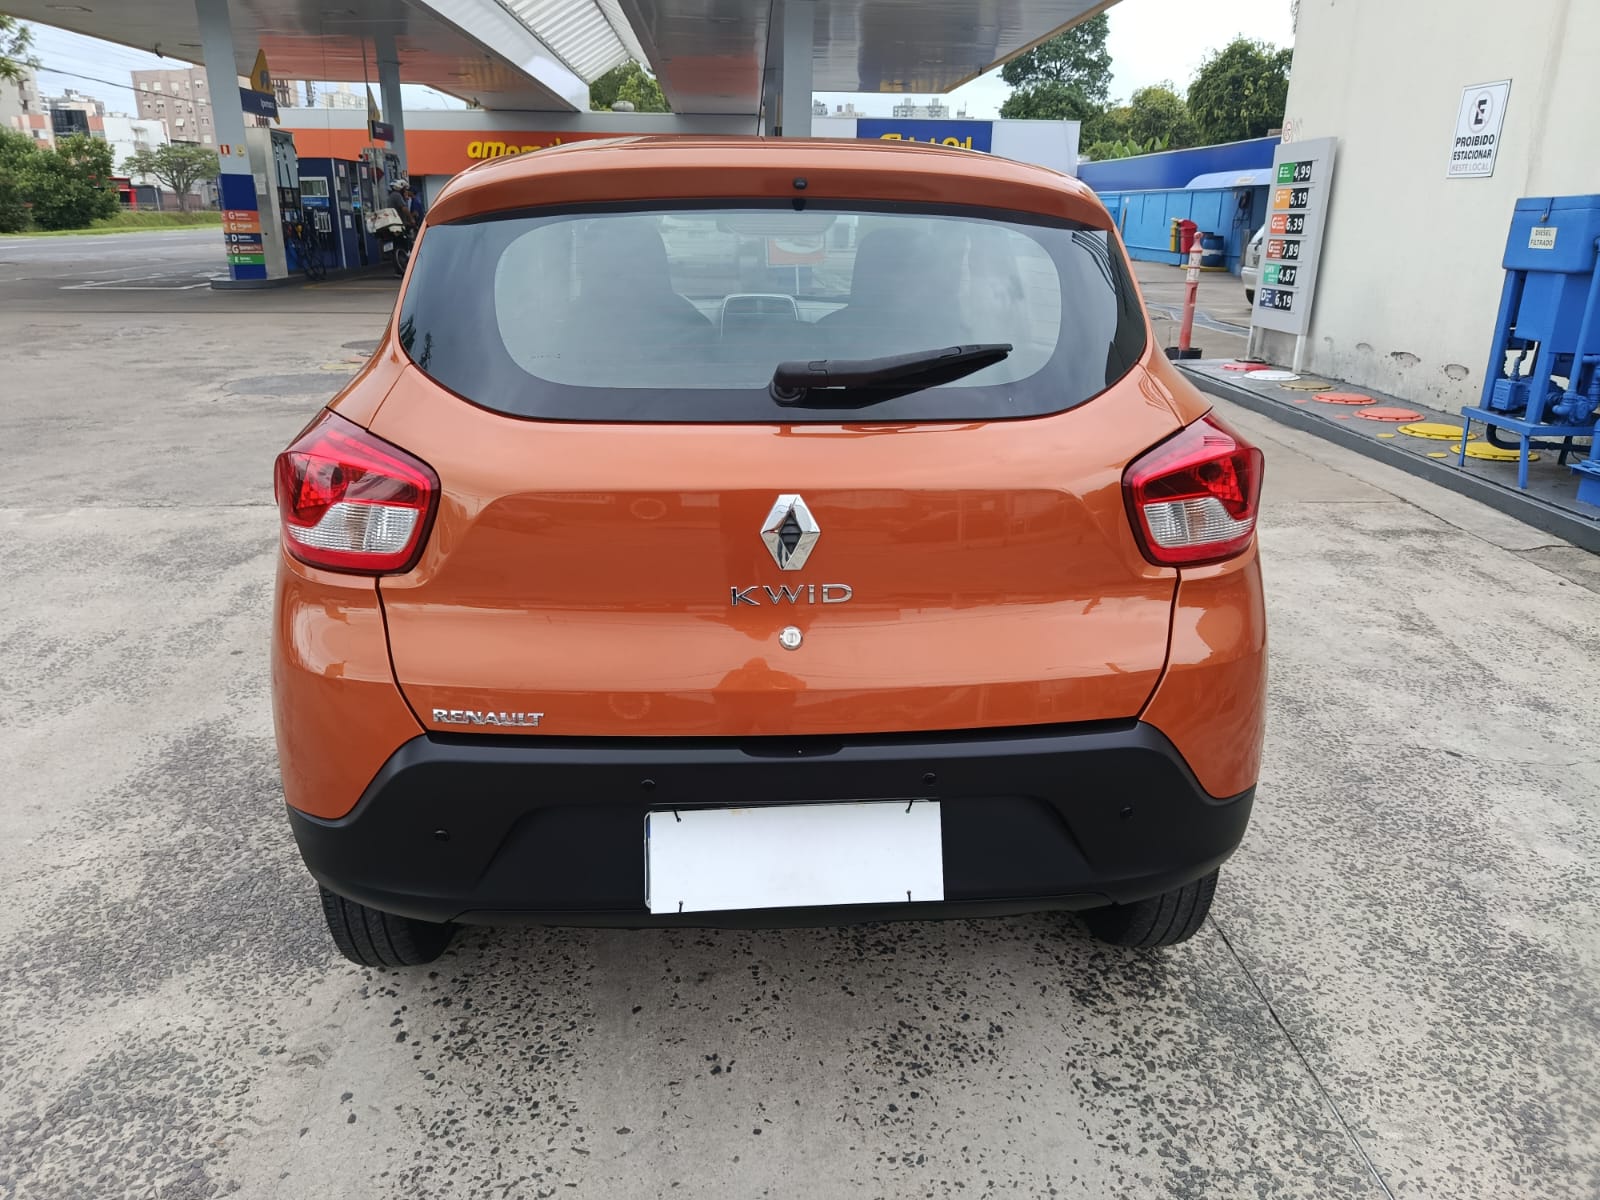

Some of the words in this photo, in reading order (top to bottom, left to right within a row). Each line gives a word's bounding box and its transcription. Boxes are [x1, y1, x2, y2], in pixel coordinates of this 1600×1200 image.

[1456, 134, 1495, 147] PROIBIDO
[1453, 150, 1492, 161] ESTACIONAR
[1294, 166, 1311, 180] 4,99
[1469, 162, 1489, 172] LOCAL
[1276, 190, 1281, 203] G
[1290, 192, 1307, 206] 6,19
[229, 212, 235, 220] G
[230, 223, 237, 231] G
[1286, 217, 1303, 231] 6,39
[231, 234, 238, 242] D
[1530, 239, 1553, 247] FILTRADO
[232, 245, 239, 253] G
[1282, 244, 1299, 258] 7,89
[1278, 269, 1296, 283] 4,87
[1261, 290, 1267, 301] D
[1274, 293, 1292, 307] 6,19
[730, 583, 853, 607] KWID
[432, 708, 545, 728] RENAULT
